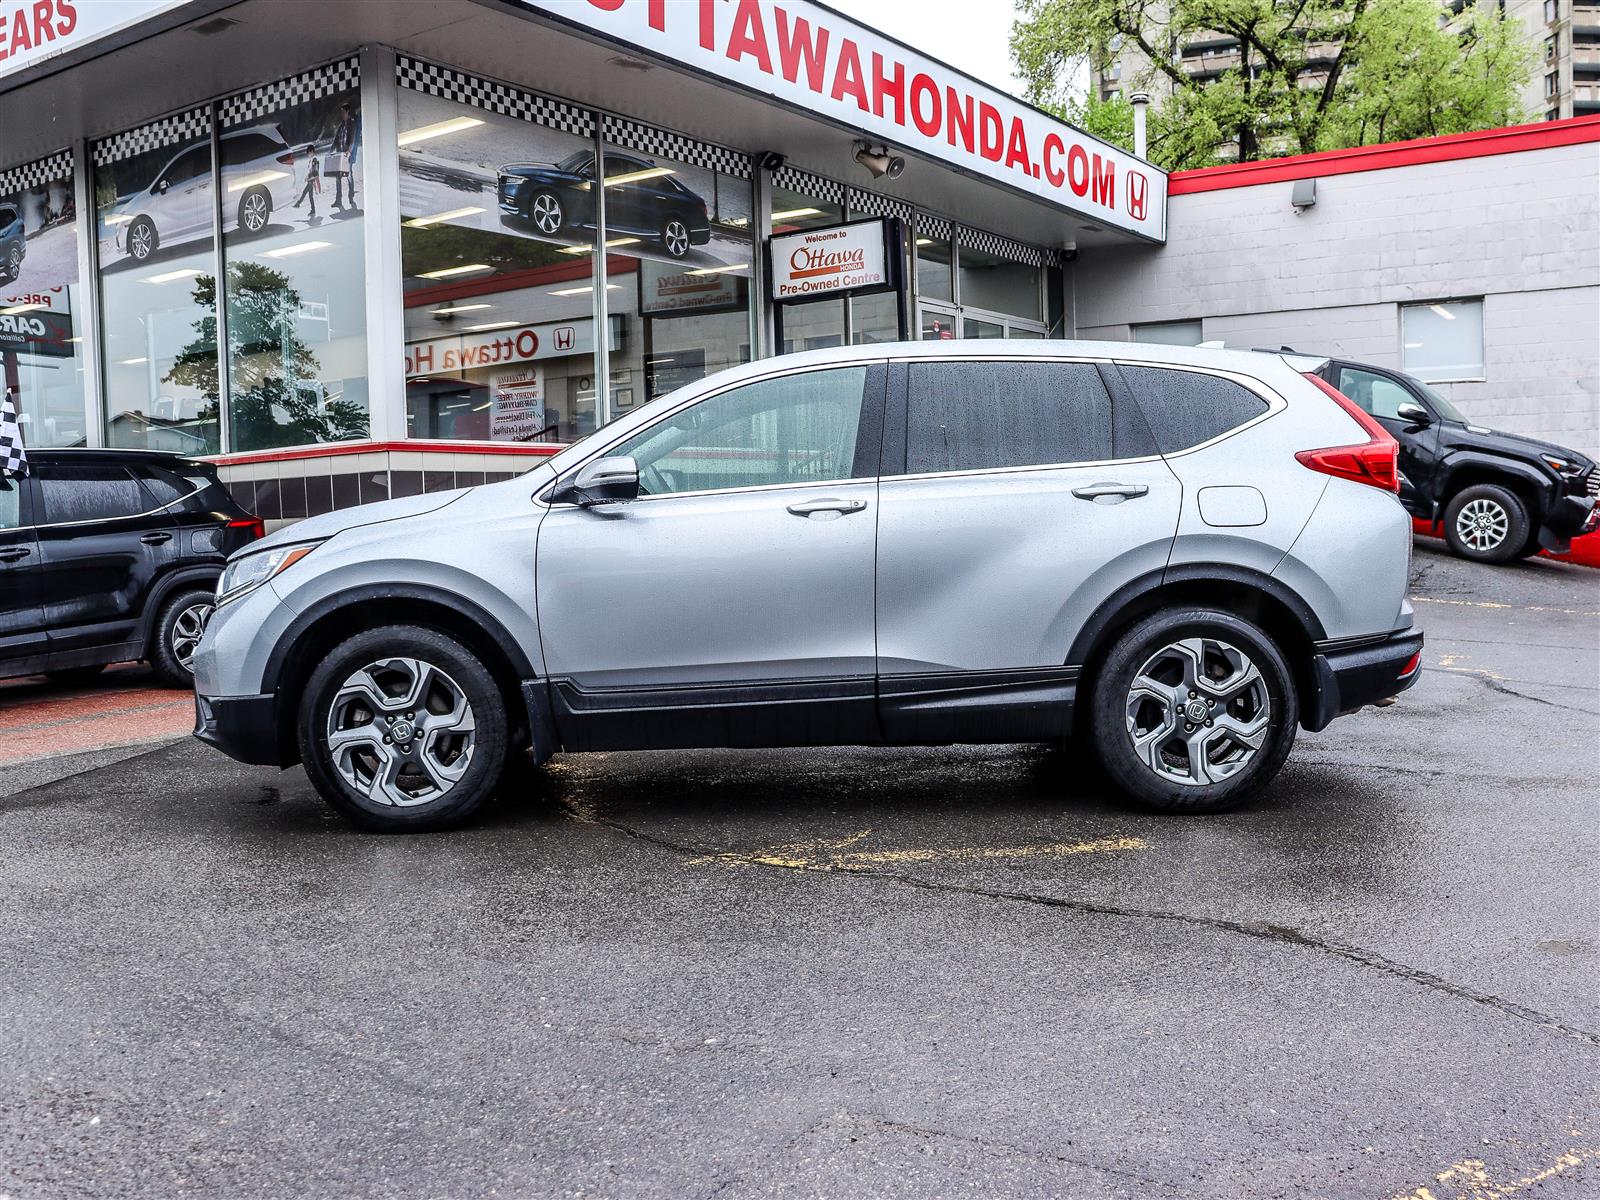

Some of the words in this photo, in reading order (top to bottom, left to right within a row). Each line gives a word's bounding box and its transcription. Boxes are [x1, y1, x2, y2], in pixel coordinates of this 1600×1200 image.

[586, 0, 1115, 210] TAWAHONDA.COM
[805, 234, 838, 244] Welcome
[790, 246, 864, 271] Ottawa
[840, 262, 863, 271] HONDA
[780, 277, 840, 295] Pre-Owned
[843, 272, 880, 286] Centre
